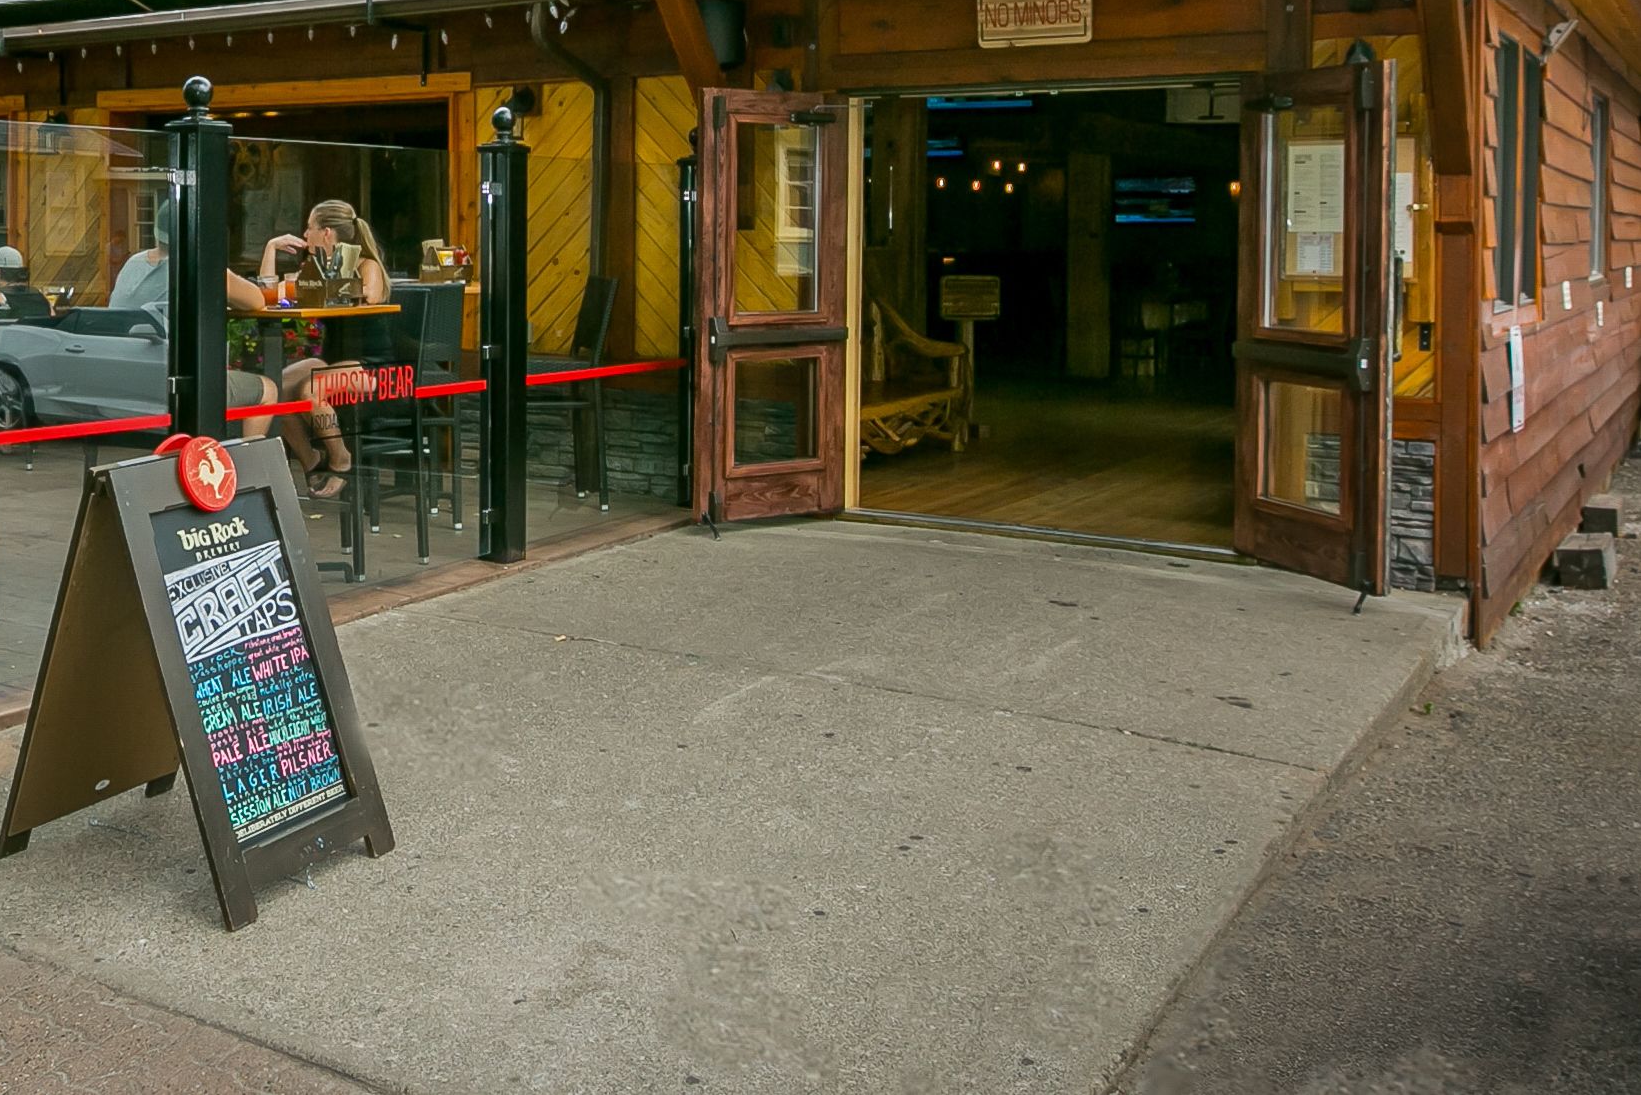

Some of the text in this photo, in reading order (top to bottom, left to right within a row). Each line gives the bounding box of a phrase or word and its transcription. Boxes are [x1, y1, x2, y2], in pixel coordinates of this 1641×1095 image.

[984, 0, 1082, 28] NO MINORS
[315, 365, 414, 406] THIRSTY BEAR
[167, 562, 231, 600] EXCLUSIVE
[174, 558, 284, 652] CRAFT
[238, 587, 298, 638] TAPS
[209, 647, 242, 663] rock
[252, 646, 309, 680] WHITE IPA
[196, 667, 252, 698] WHEAT ALE
[263, 682, 317, 716] IRISH ALE
[203, 700, 262, 733] CREAM ALE
[213, 732, 271, 768] PALE ALE
[280, 742, 333, 775] PILSNER
[223, 764, 280, 800] LAGER
[288, 768, 340, 801] NUT BROWN
[230, 789, 289, 826] SESSION ALE
[236, 810, 286, 838] DELIBERATELY
[288, 793, 325, 814] DIFFERENT
